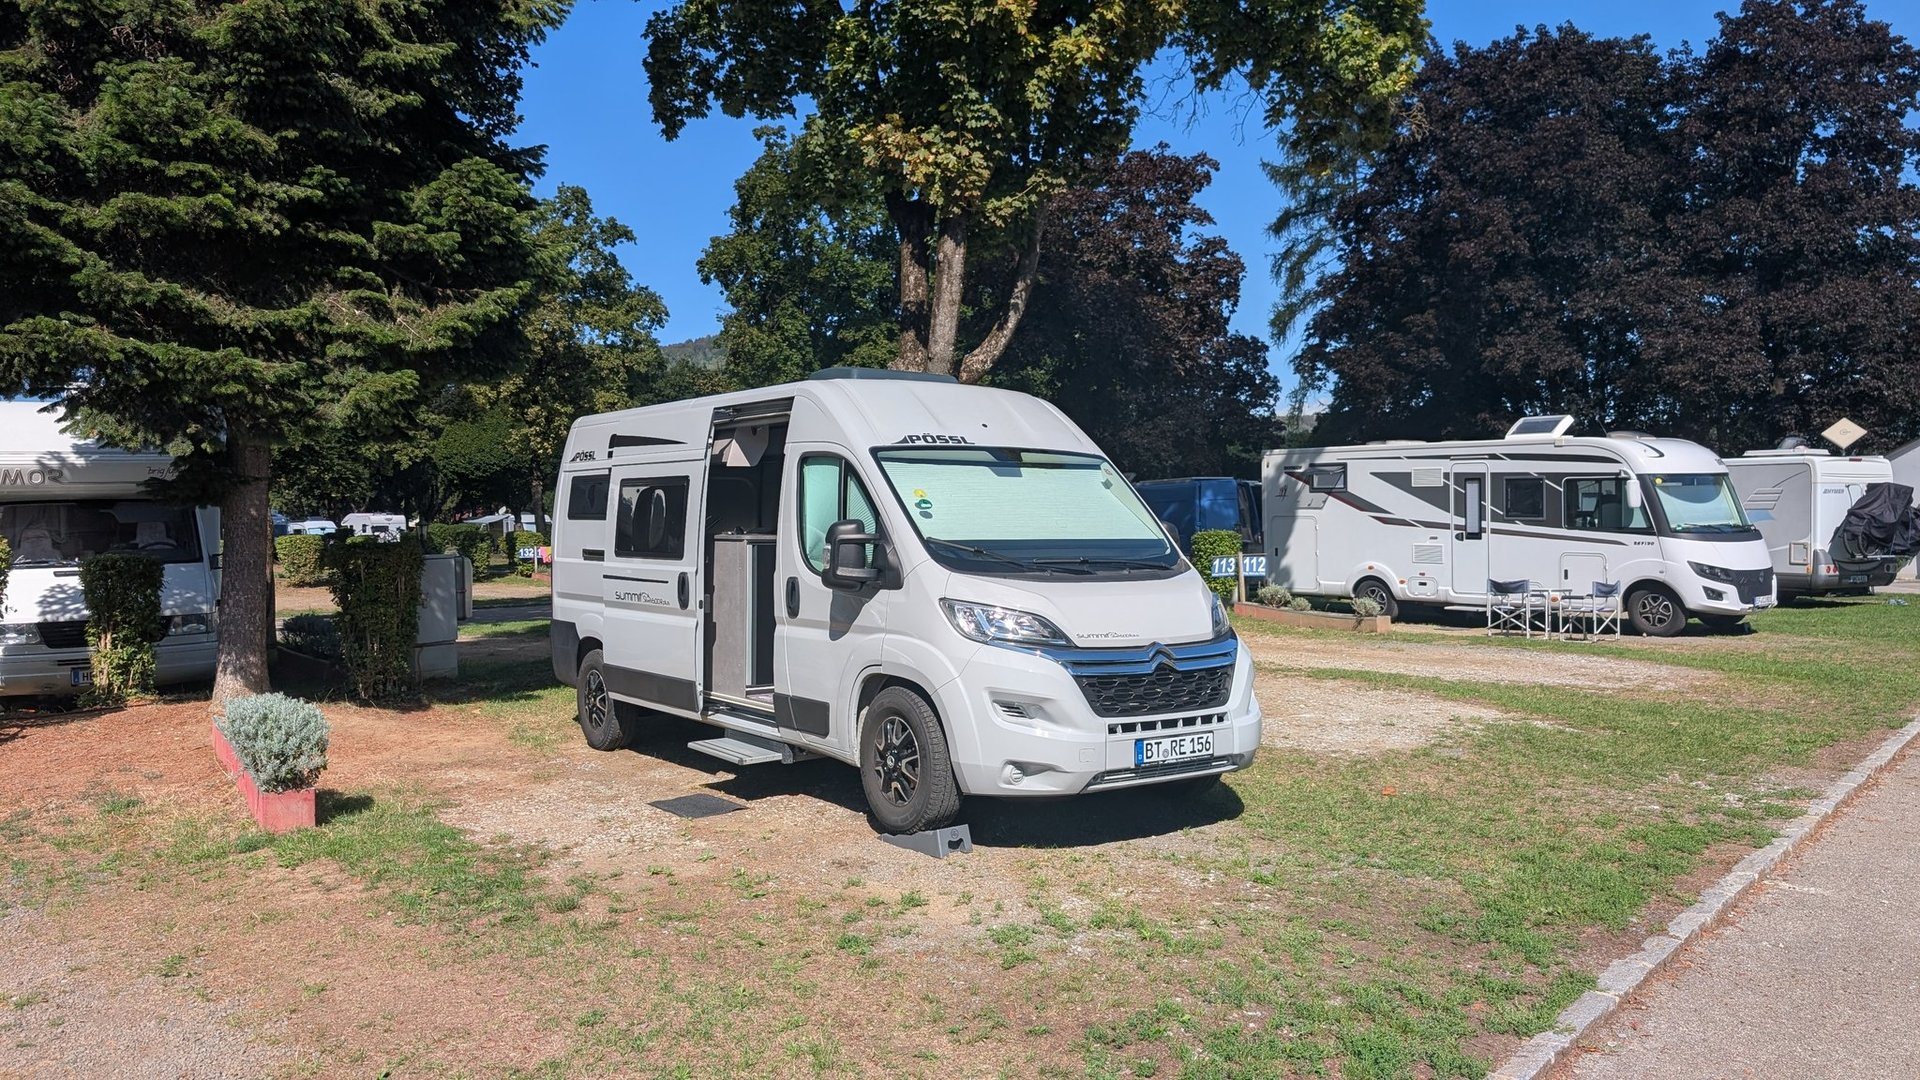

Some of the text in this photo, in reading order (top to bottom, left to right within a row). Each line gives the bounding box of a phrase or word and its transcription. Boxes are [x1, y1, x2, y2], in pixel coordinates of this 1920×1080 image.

[906, 432, 975, 445] PÖSSL
[519, 548, 535, 558] 132
[1213, 557, 1236, 573] 113
[1243, 556, 1266, 572] 112
[1145, 735, 1211, 759] BT RE 156
